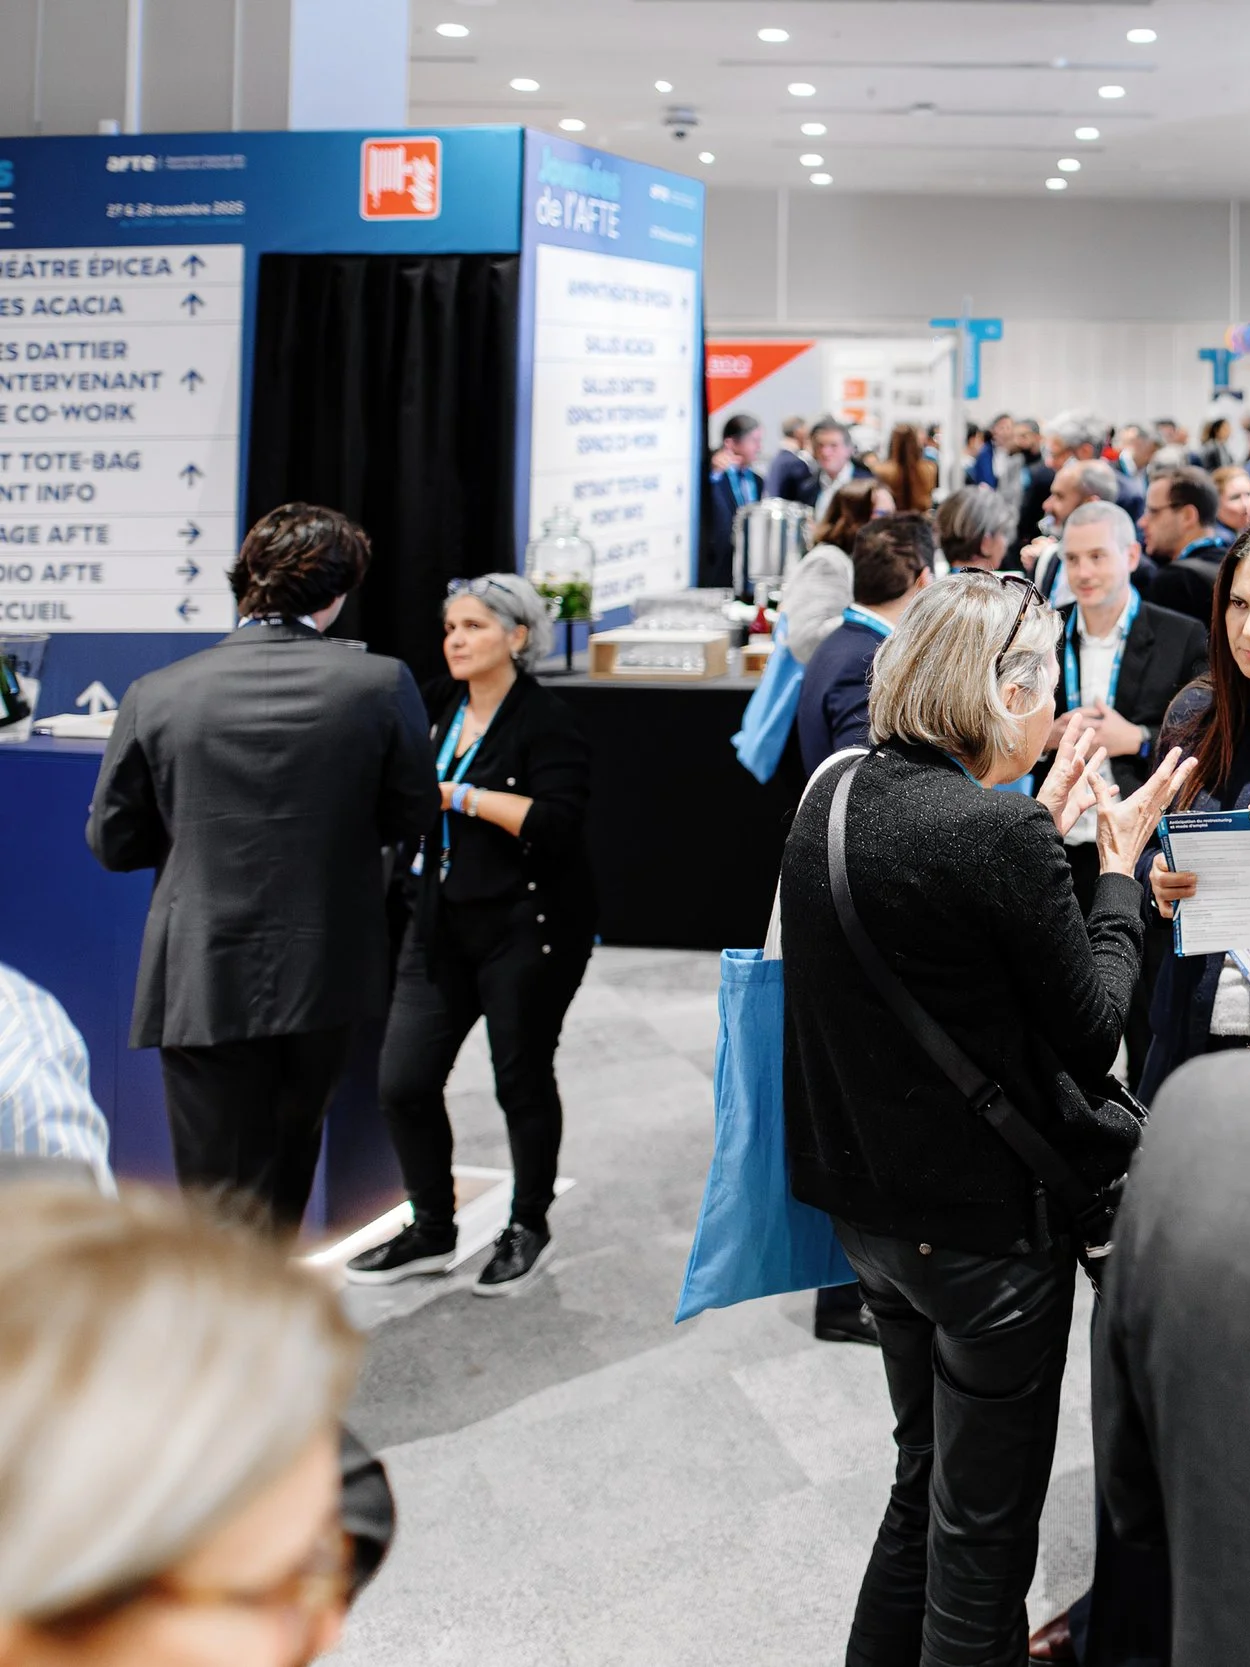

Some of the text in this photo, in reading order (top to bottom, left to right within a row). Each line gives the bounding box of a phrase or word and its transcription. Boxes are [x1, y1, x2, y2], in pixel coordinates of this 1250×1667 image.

[0, 252, 173, 278] ÉÂTRE ÉPICEA
[32, 297, 124, 315] ACACIA
[26, 340, 128, 360] DATTIER
[15, 403, 135, 423] CO-WORK
[21, 451, 141, 471] TOTE-BAG
[37, 483, 95, 501] INFO
[48, 523, 110, 544] AFTE
[41, 563, 103, 582] AFTE
[0, 603, 72, 621] CUEIL
